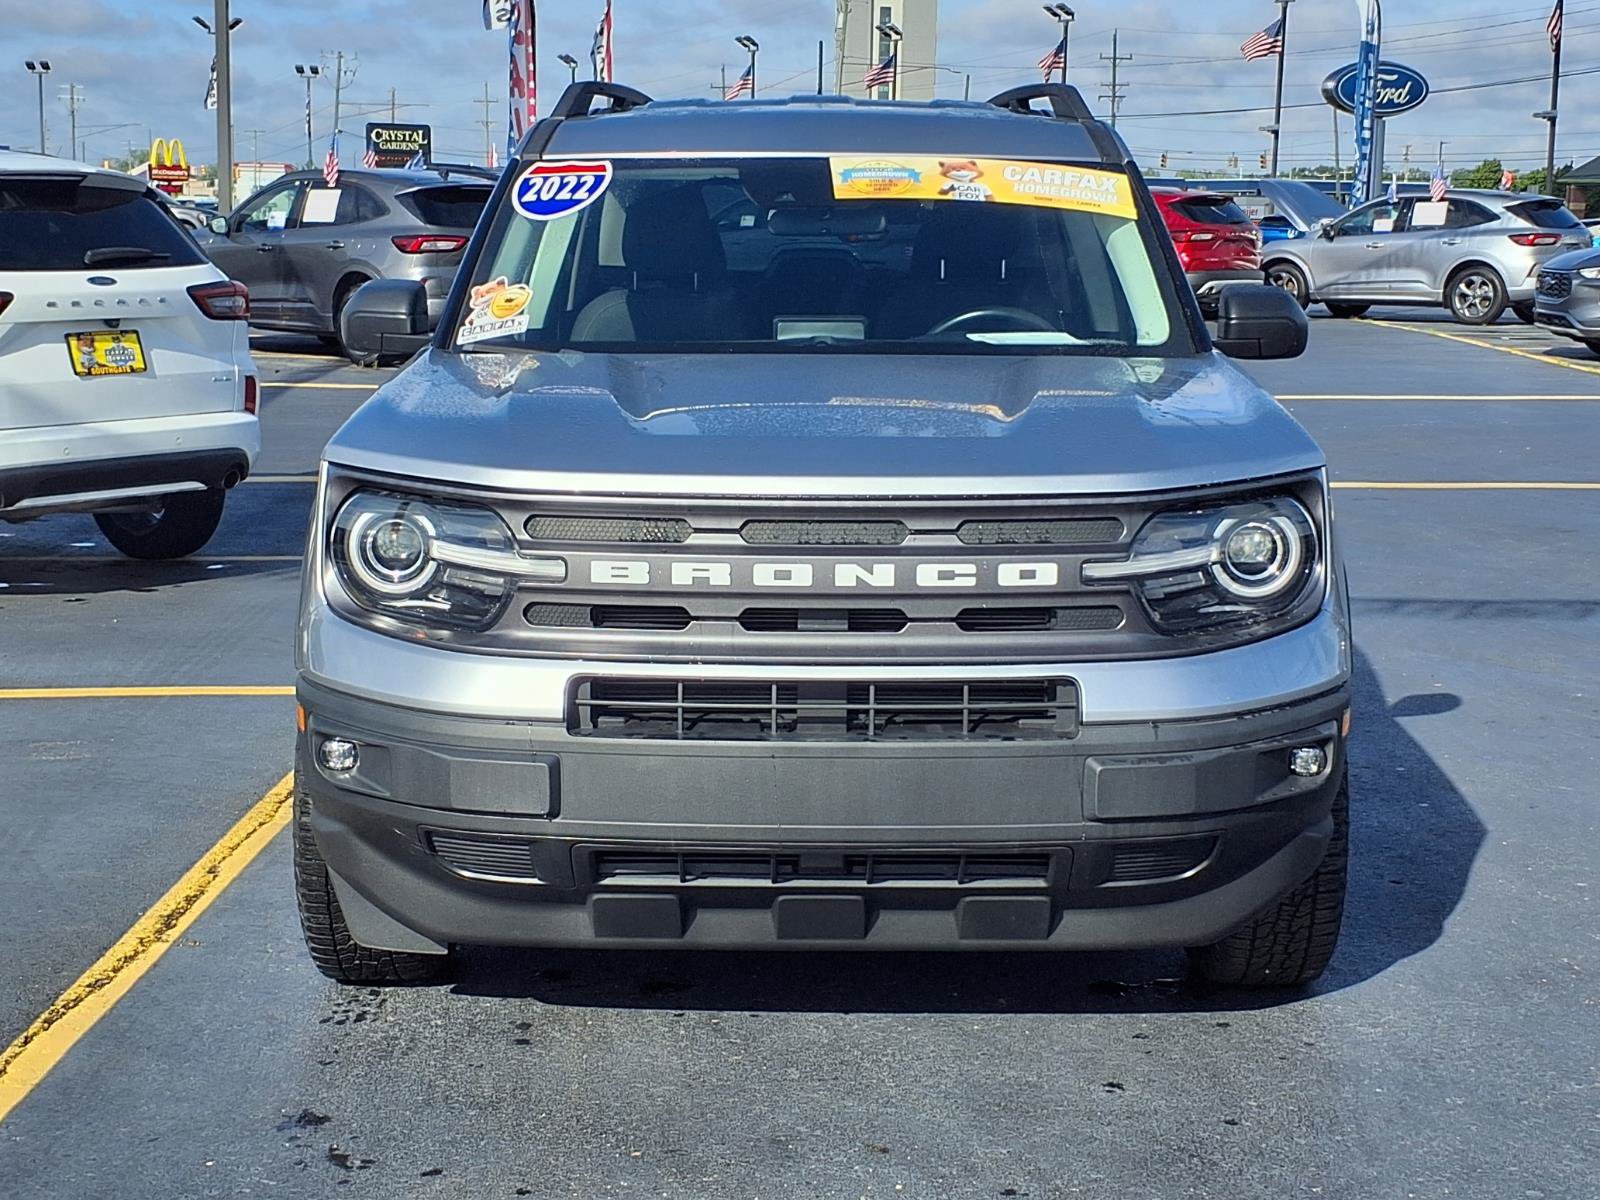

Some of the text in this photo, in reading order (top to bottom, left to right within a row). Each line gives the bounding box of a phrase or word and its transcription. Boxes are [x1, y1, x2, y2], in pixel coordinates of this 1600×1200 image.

[1375, 73, 1412, 104] ord
[371, 129, 428, 144] CRYSTAL
[379, 141, 419, 151] GARDENS
[520, 175, 596, 203] 2022
[958, 185, 981, 193] CAR
[1003, 165, 1119, 193] CARFAX
[1013, 182, 1118, 204] HOMEGROWN
[461, 319, 524, 337] CARFAX
[90, 366, 131, 375] SOUTHGATE
[590, 560, 1058, 587] BRONCO
